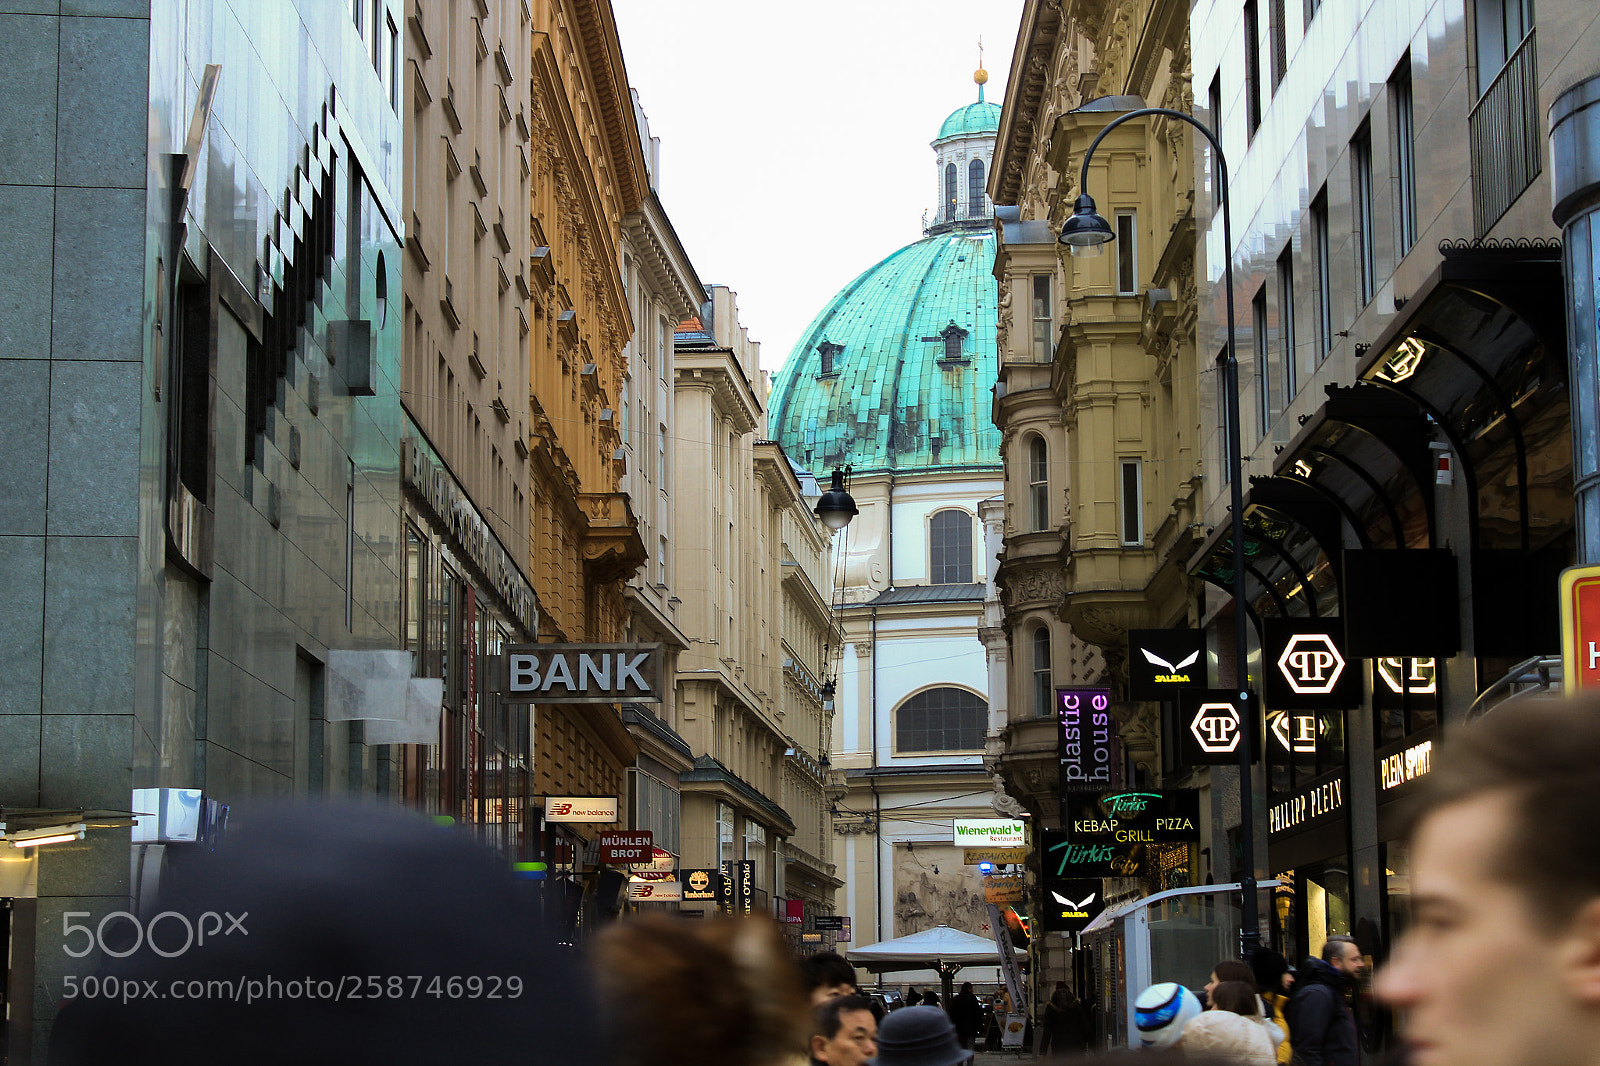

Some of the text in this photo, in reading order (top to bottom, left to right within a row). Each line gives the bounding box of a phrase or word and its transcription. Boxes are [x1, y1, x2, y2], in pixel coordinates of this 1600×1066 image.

[510, 652, 651, 692] BANK
[1060, 694, 1087, 782] plastic
[1089, 694, 1110, 782] house
[1381, 740, 1432, 790] PLEIN SPORT
[1103, 793, 1163, 819] Türkis
[1269, 778, 1342, 833] PHILIPP PLEIN
[602, 835, 651, 846] MÜHLEN
[956, 825, 1012, 836] Wienerwald
[1074, 818, 1194, 842] KEBAP GRILL PIZZA
[611, 849, 642, 858] BROT
[966, 851, 1024, 862] RESTAURANT
[1049, 841, 1116, 876] Türkis
[1110, 855, 1139, 876] City
[743, 863, 751, 896] O'Polo
[683, 890, 715, 899] Timberland
